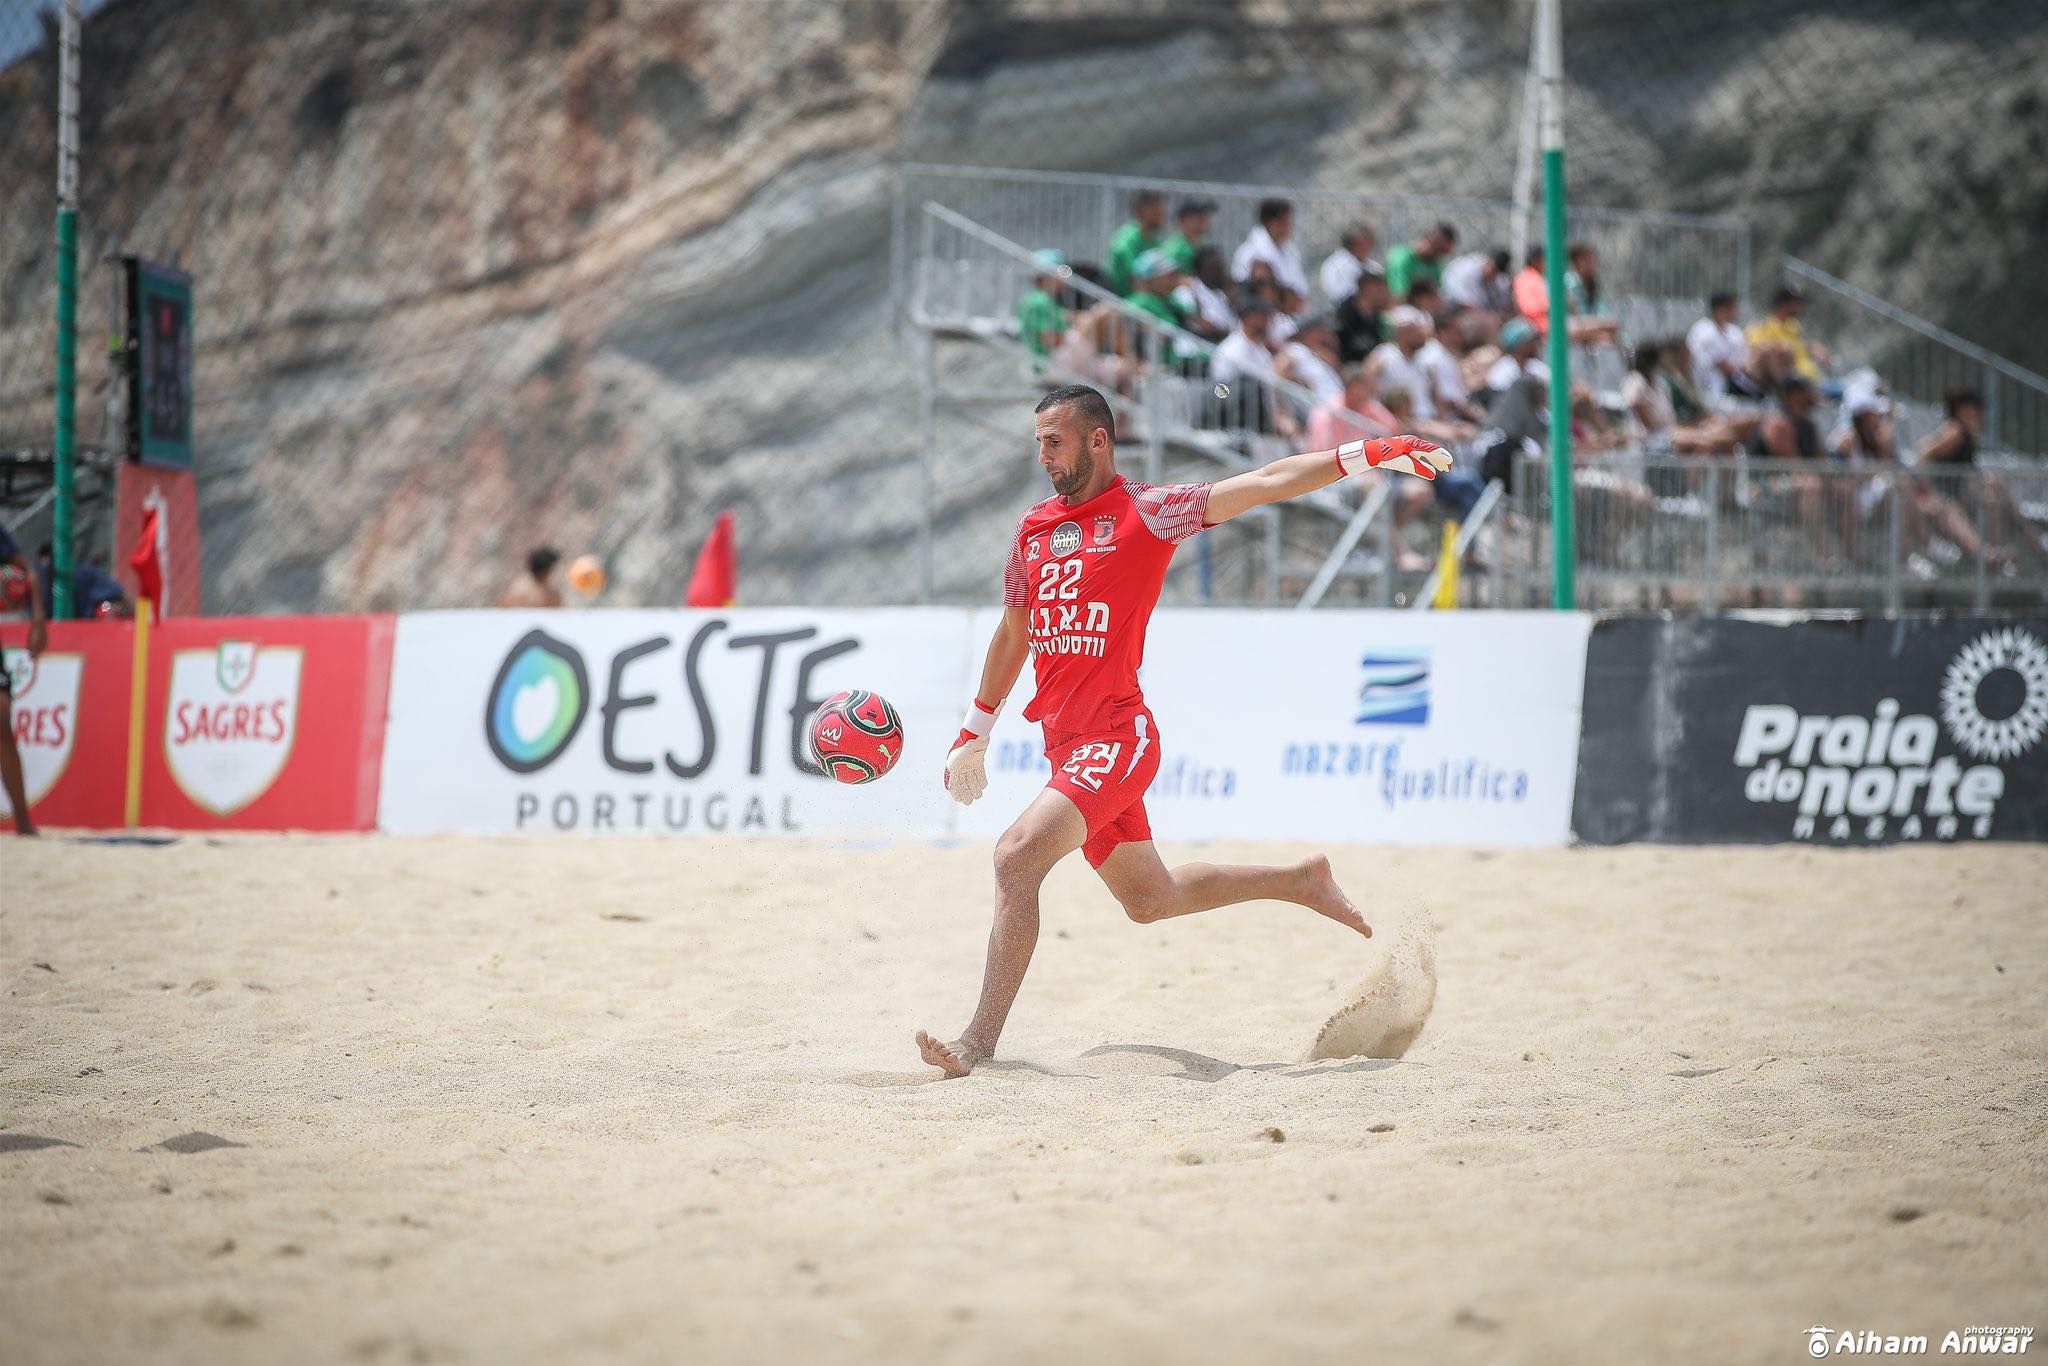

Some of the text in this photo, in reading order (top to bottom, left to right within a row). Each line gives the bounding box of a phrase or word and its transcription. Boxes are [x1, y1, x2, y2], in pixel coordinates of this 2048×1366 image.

[1038, 558, 1083, 600] 22
[173, 700, 286, 746] SAGRES
[486, 619, 859, 779] OESTE
[14, 704, 68, 747] RES
[1733, 697, 1938, 768] Praia
[1381, 756, 1529, 808] qualifica
[1745, 755, 2005, 817] do norte
[515, 793, 803, 831] PORTUGAL
